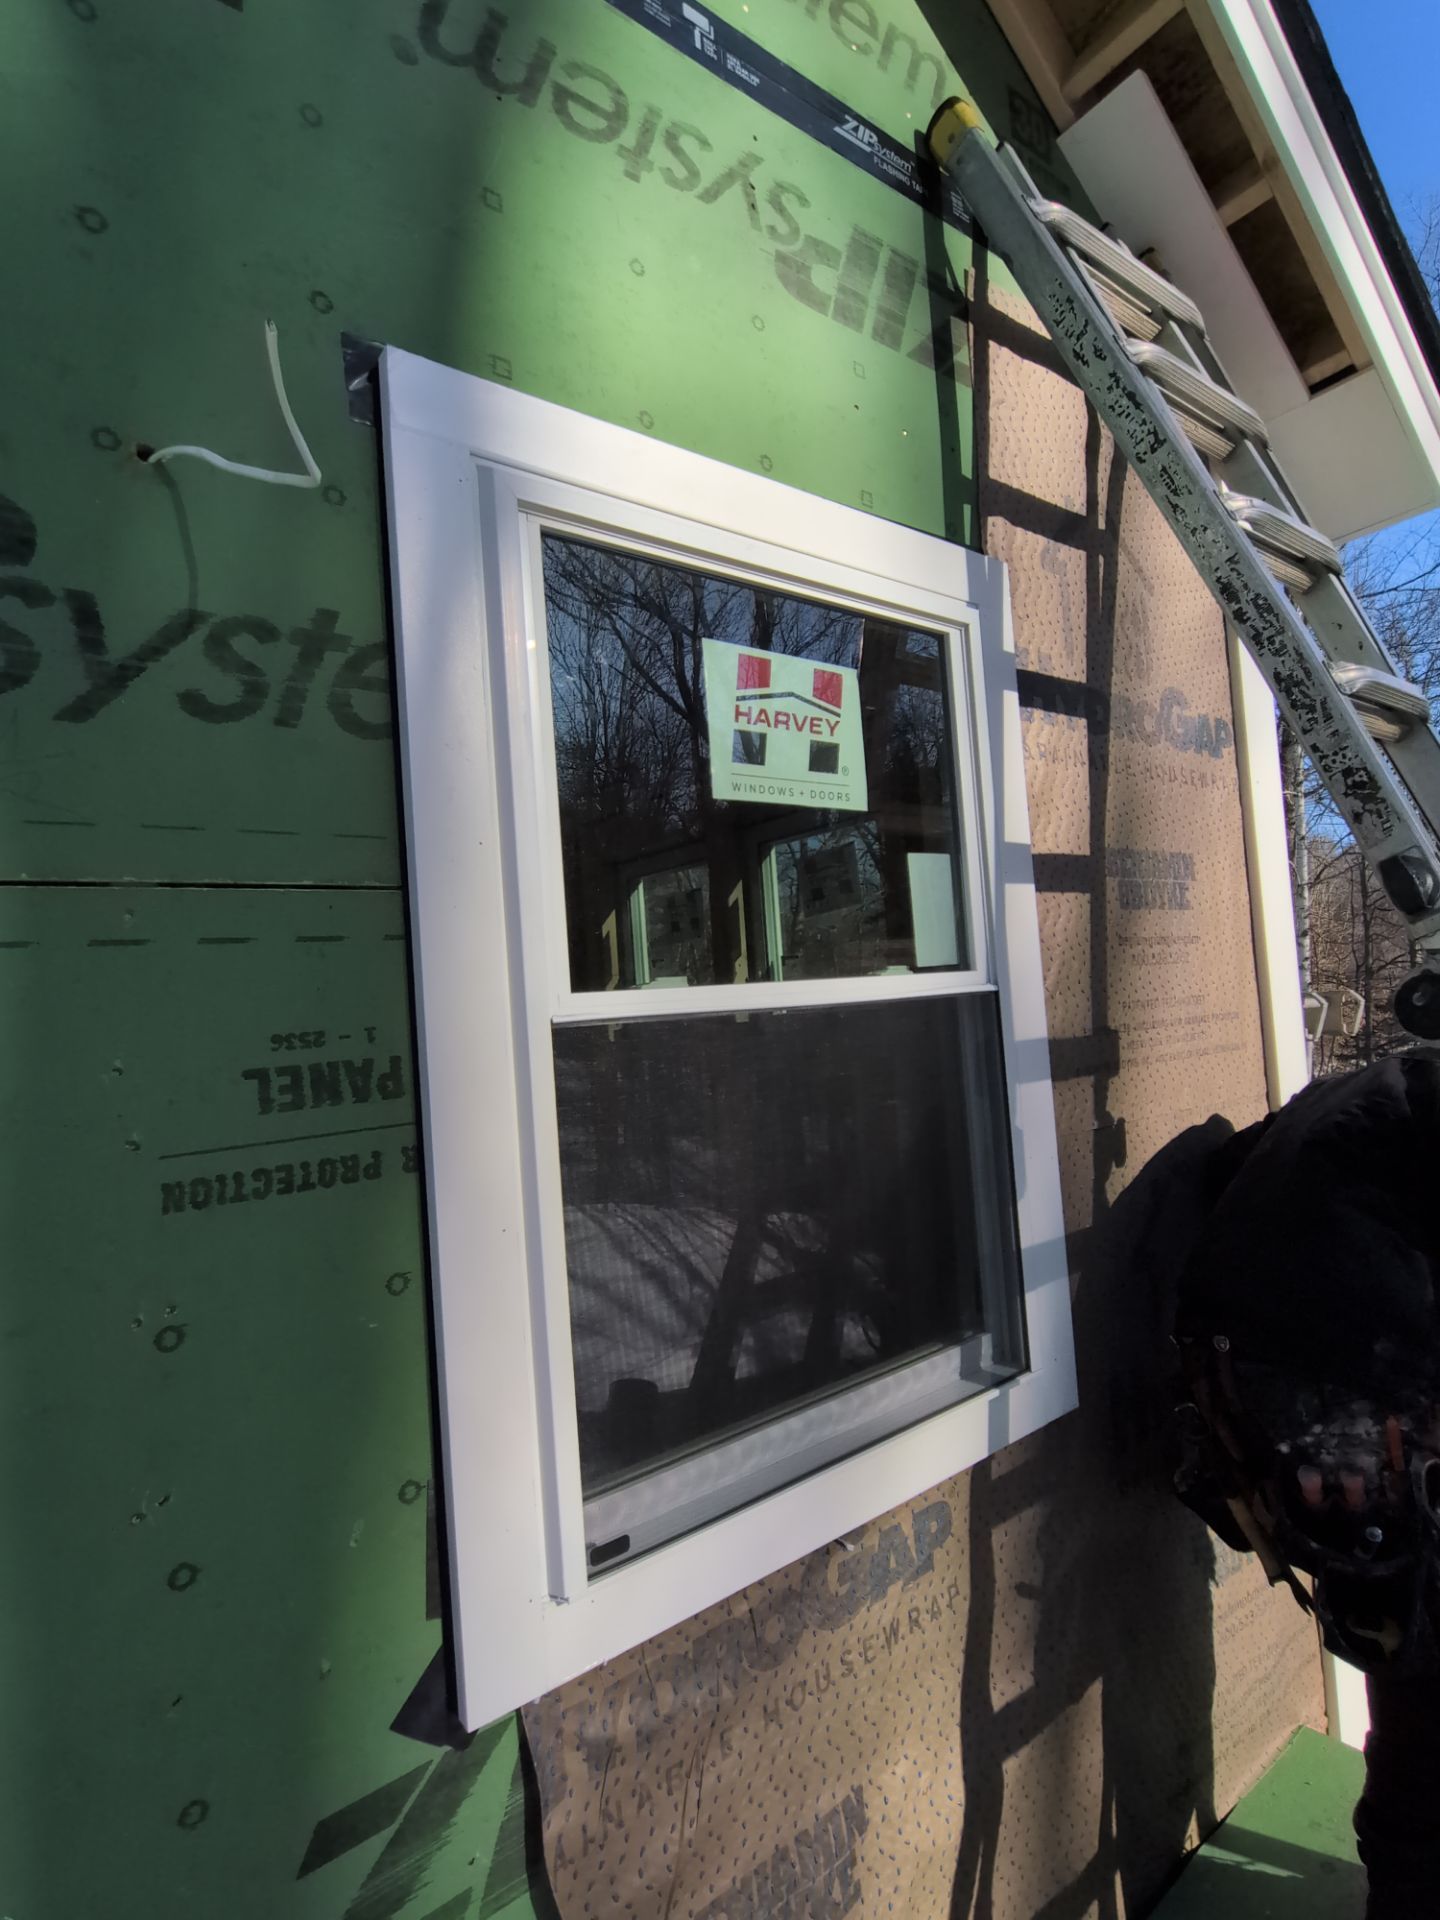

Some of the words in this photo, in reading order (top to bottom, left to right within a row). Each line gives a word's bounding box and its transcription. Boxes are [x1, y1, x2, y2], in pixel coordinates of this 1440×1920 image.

[841, 114, 879, 146] ZIP
[873, 155, 911, 186] FLASHING
[734, 704, 840, 737] HARVEY
[731, 781, 794, 797] WINDOWS
[810, 789, 850, 802] DOORS
[270, 1030, 326, 1051] 2536
[241, 1055, 405, 1115] PANEL
[160, 1150, 383, 1216] PROTECTION
[763, 1576, 961, 1733] HOUSEWRAP
